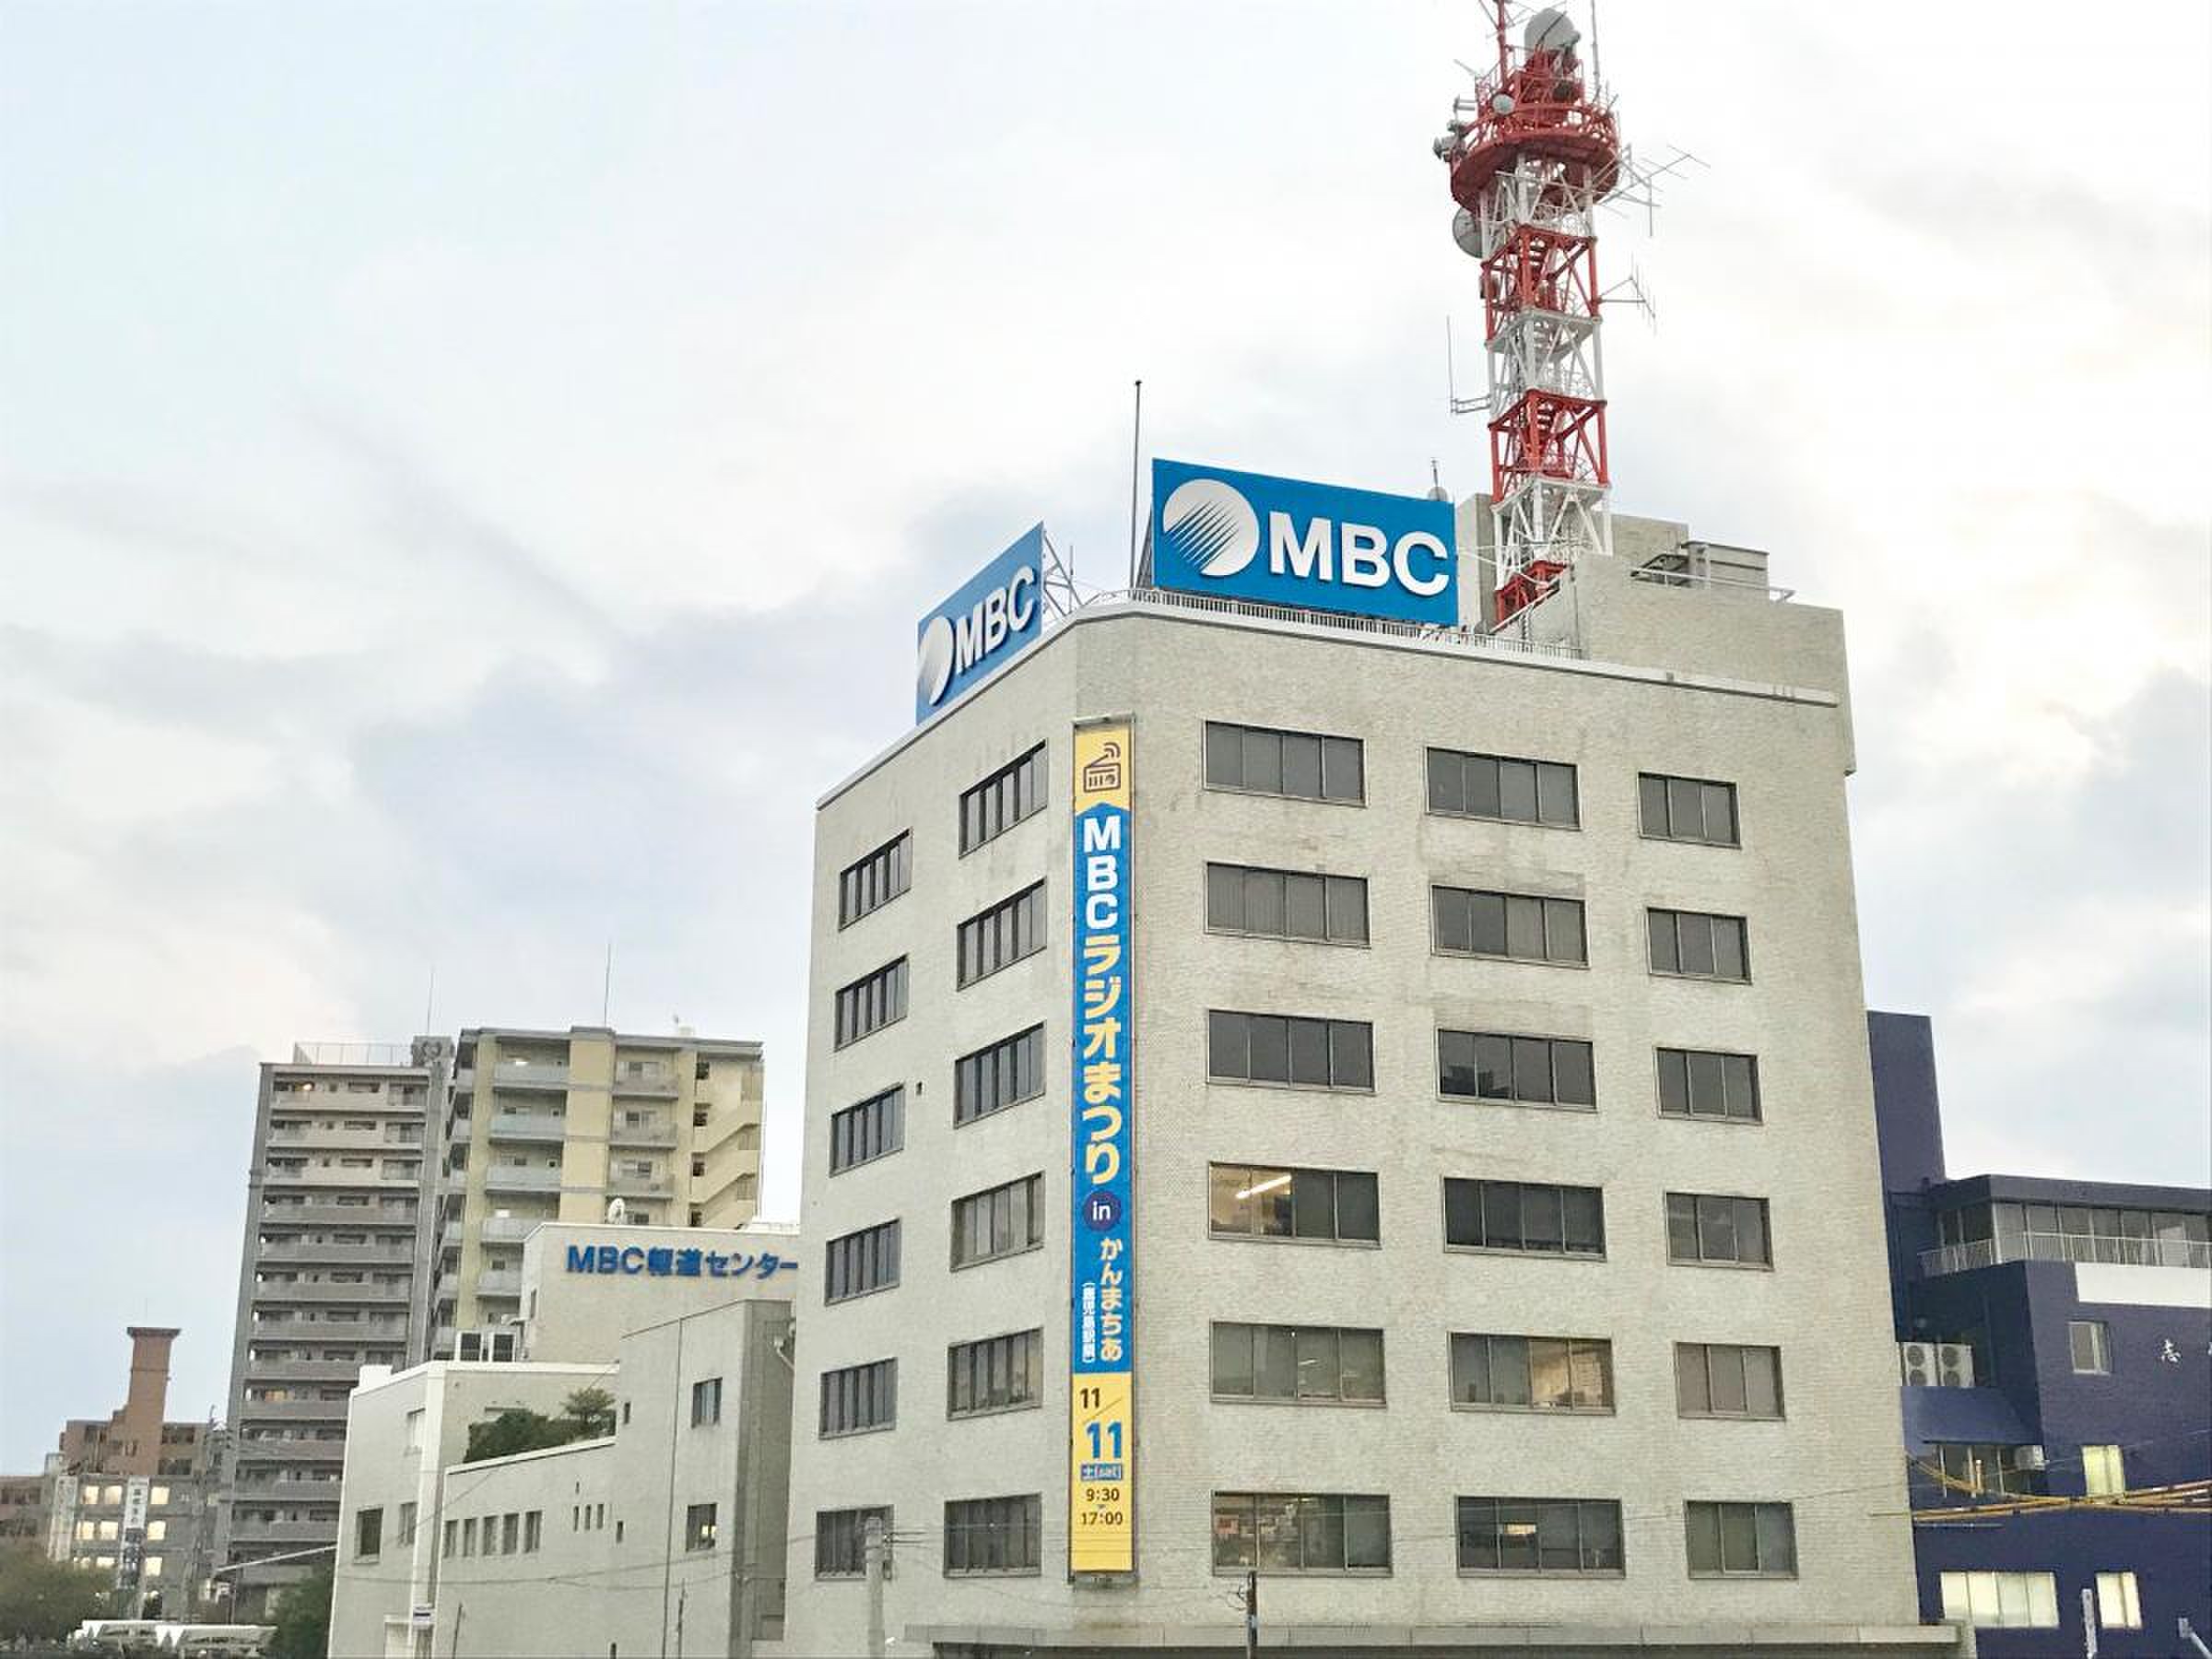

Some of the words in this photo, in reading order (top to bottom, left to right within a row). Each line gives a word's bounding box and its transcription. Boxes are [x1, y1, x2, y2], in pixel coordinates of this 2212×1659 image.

[1269, 512, 1451, 597] MBC
[955, 566, 1036, 676] MBC
[1083, 815, 1122, 1184] MBCラジオまつり
[1092, 1201, 1111, 1221] in
[1100, 1236, 1123, 1362] かんまちあ
[1080, 1388, 1100, 1408] 11
[1086, 1420, 1122, 1459] 11
[1086, 1488, 1120, 1501] 9:30
[1080, 1512, 1123, 1525] 17:00
